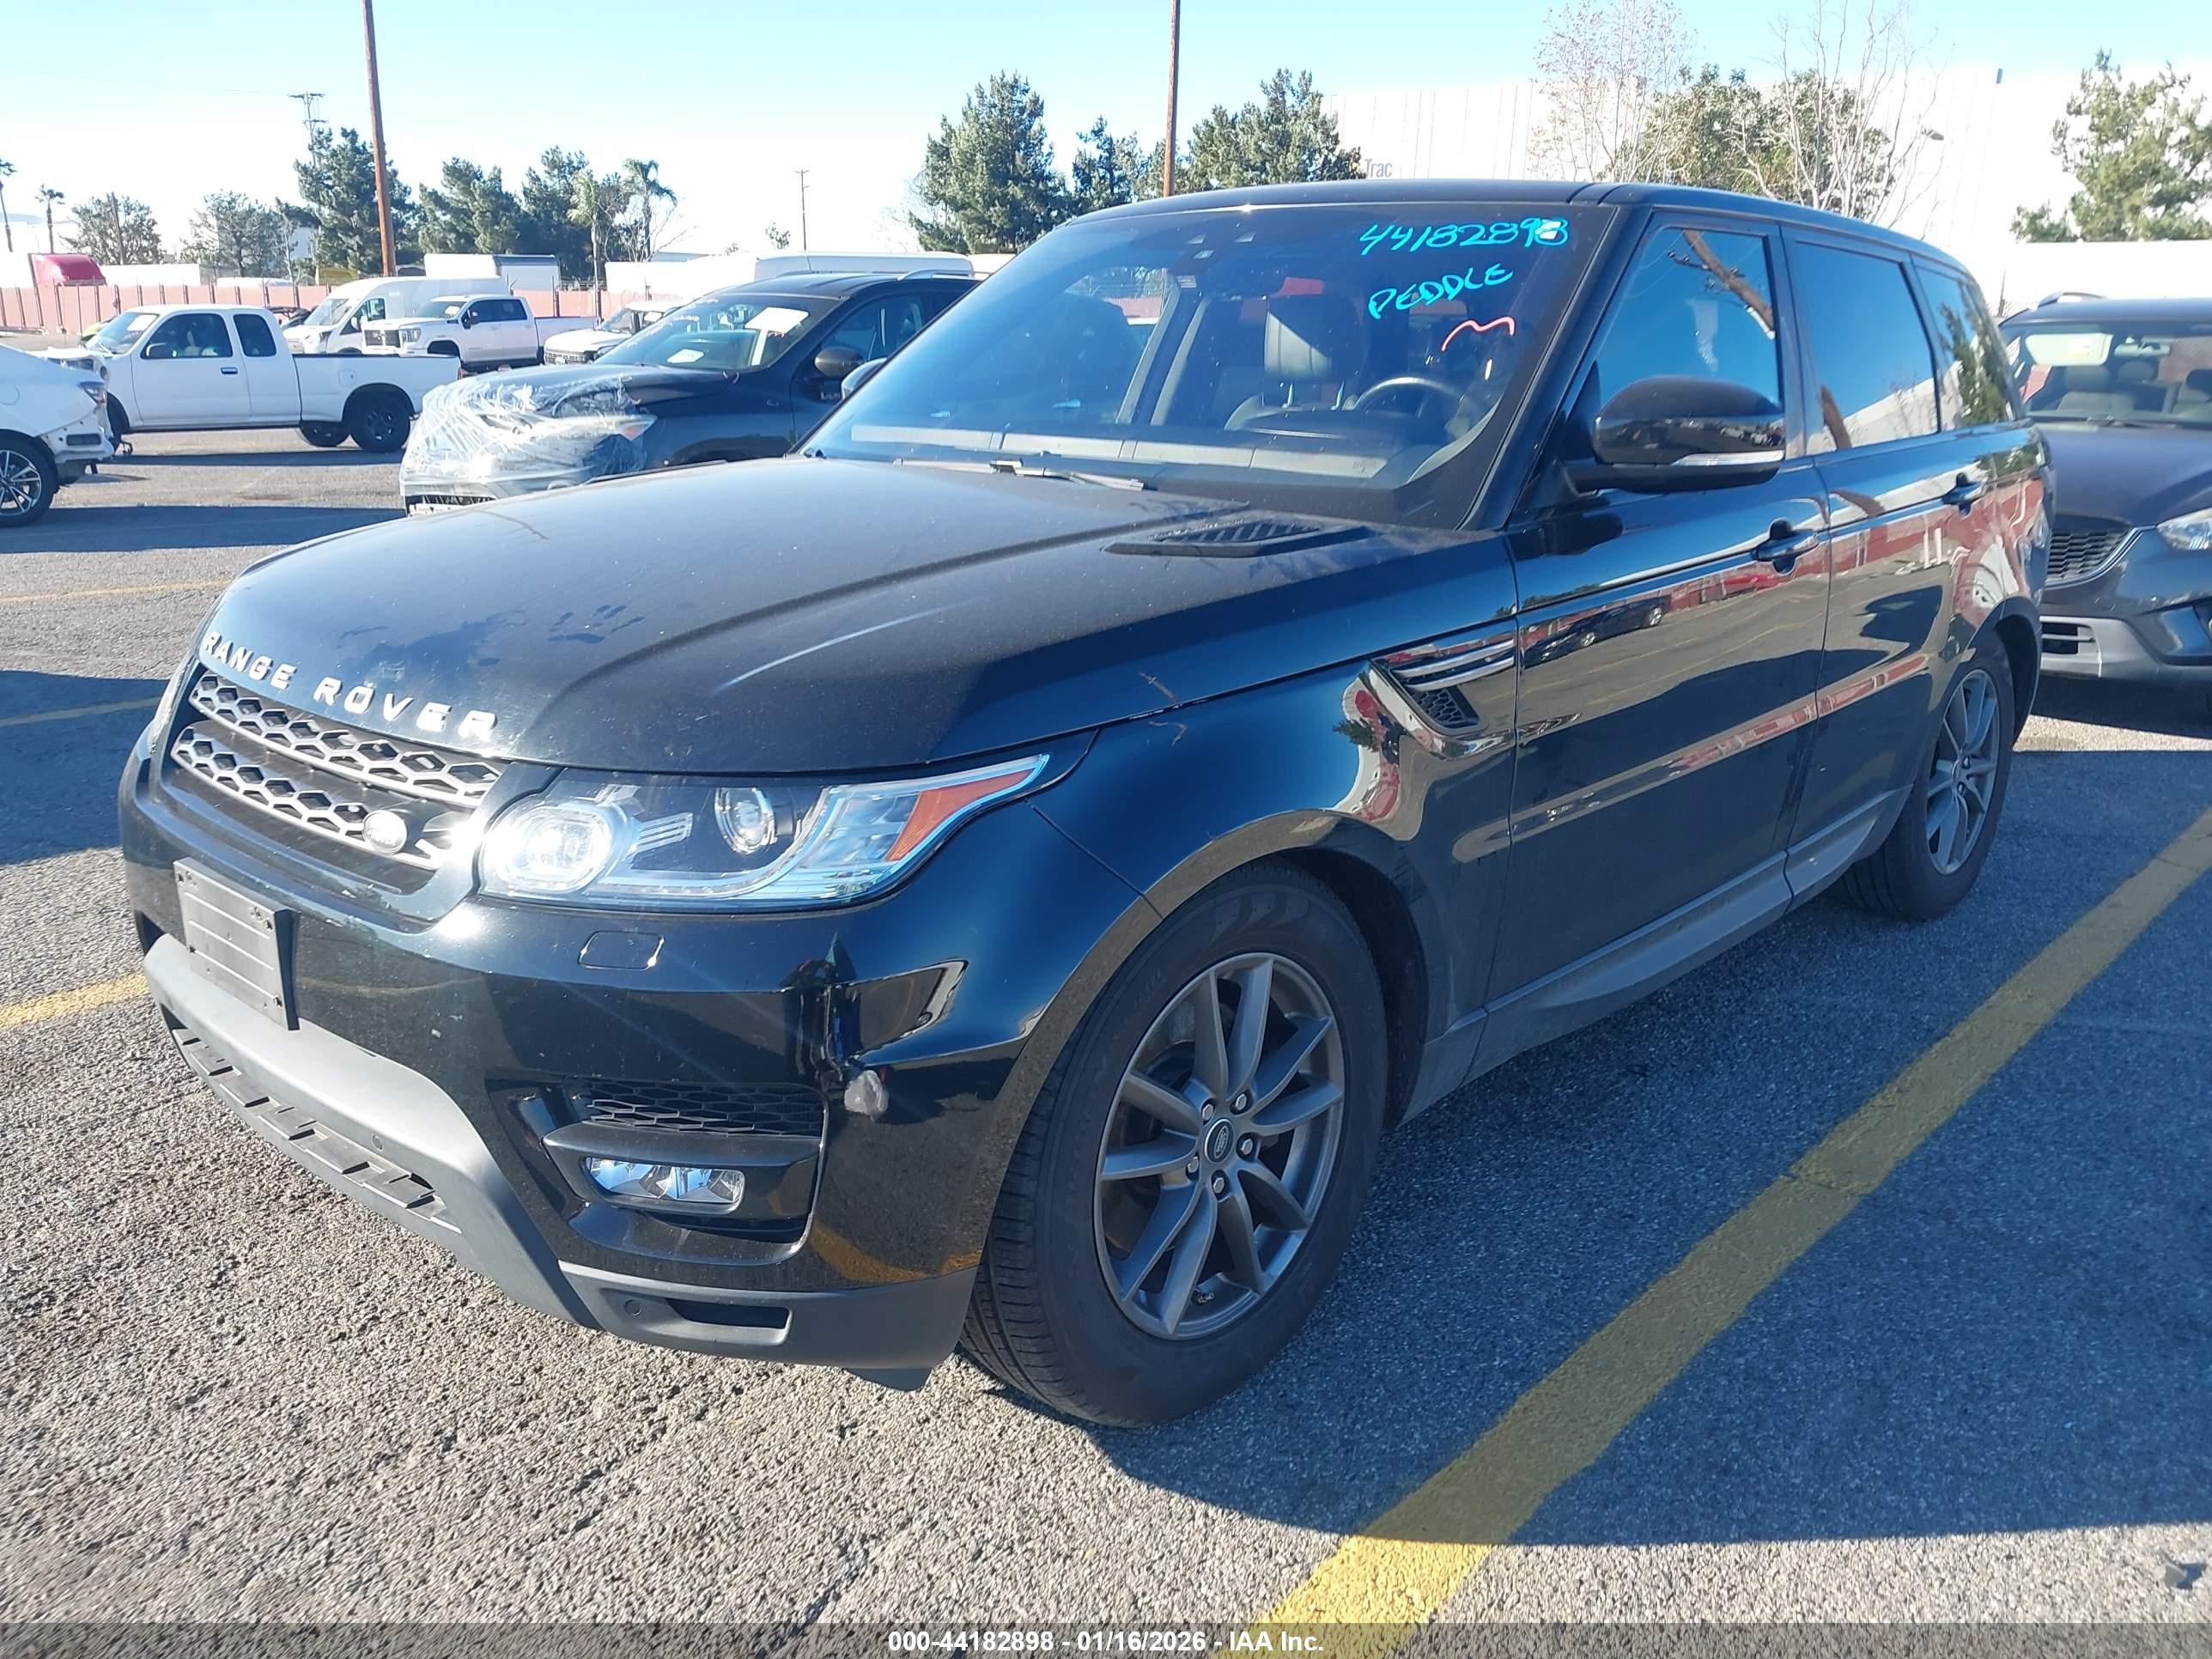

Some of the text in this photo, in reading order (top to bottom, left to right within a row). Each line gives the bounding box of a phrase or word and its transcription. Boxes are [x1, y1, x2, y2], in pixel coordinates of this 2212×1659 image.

[1359, 217, 1569, 256] 44182898
[1368, 263, 1514, 319] PEDDLE
[200, 631, 498, 743] RANGE ROVER
